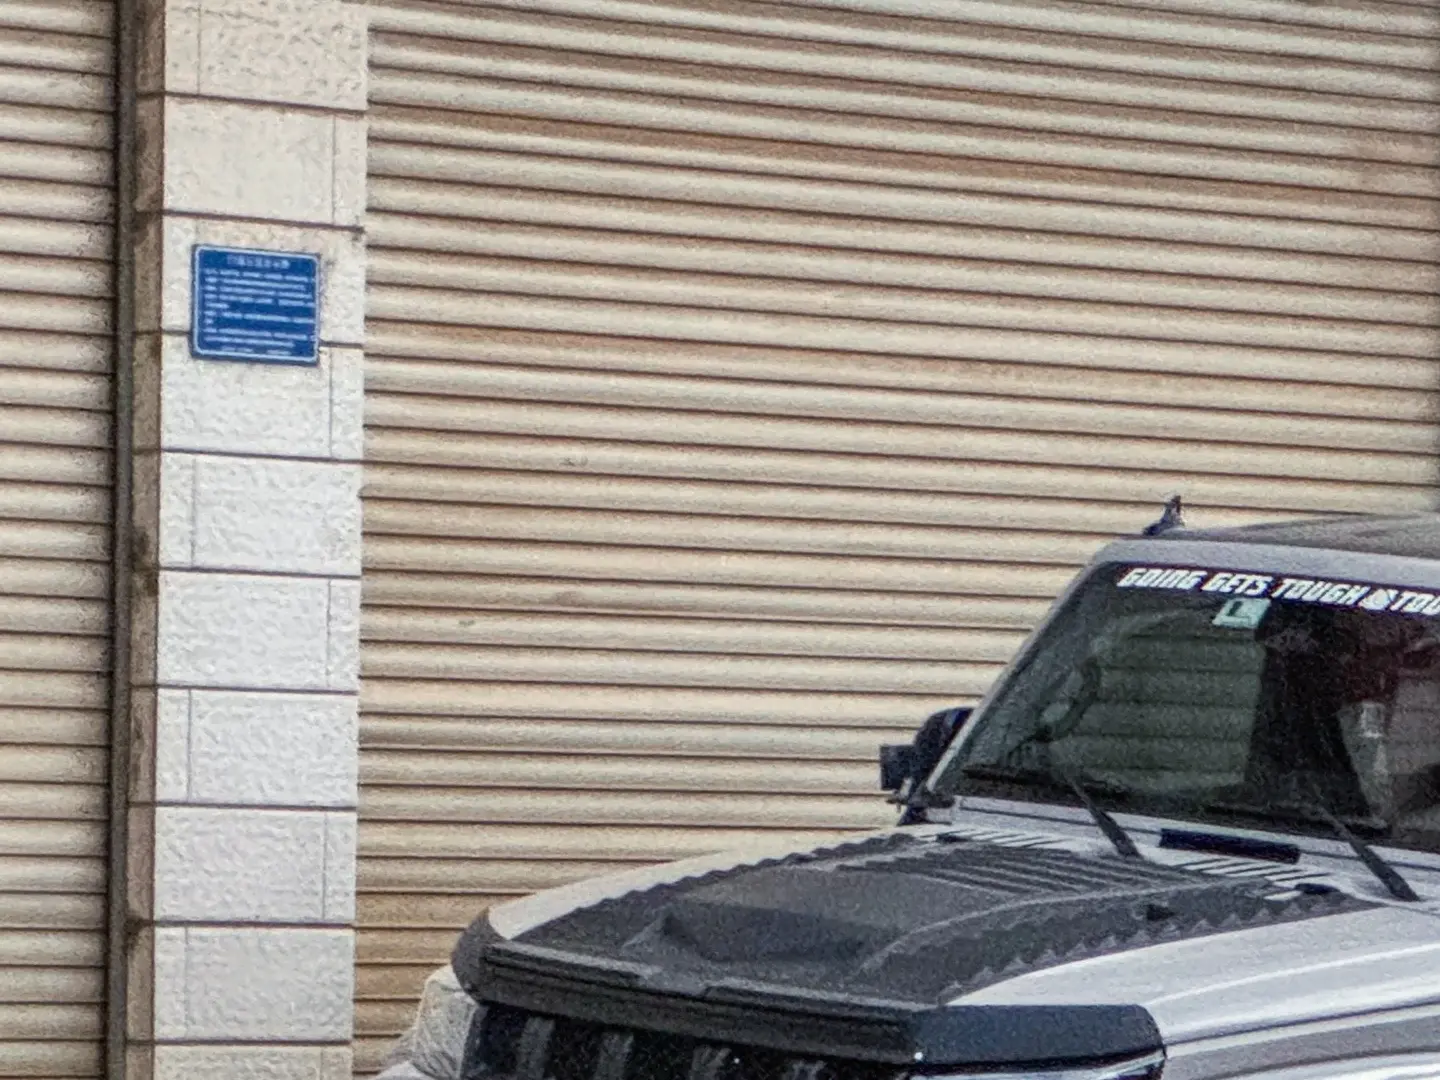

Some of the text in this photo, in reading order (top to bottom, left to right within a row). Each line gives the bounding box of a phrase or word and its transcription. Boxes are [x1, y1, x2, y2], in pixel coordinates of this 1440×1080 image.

[1116, 567, 1208, 590] GOING
[1201, 572, 1274, 595] GETS
[1271, 578, 1370, 606] TOUGH
